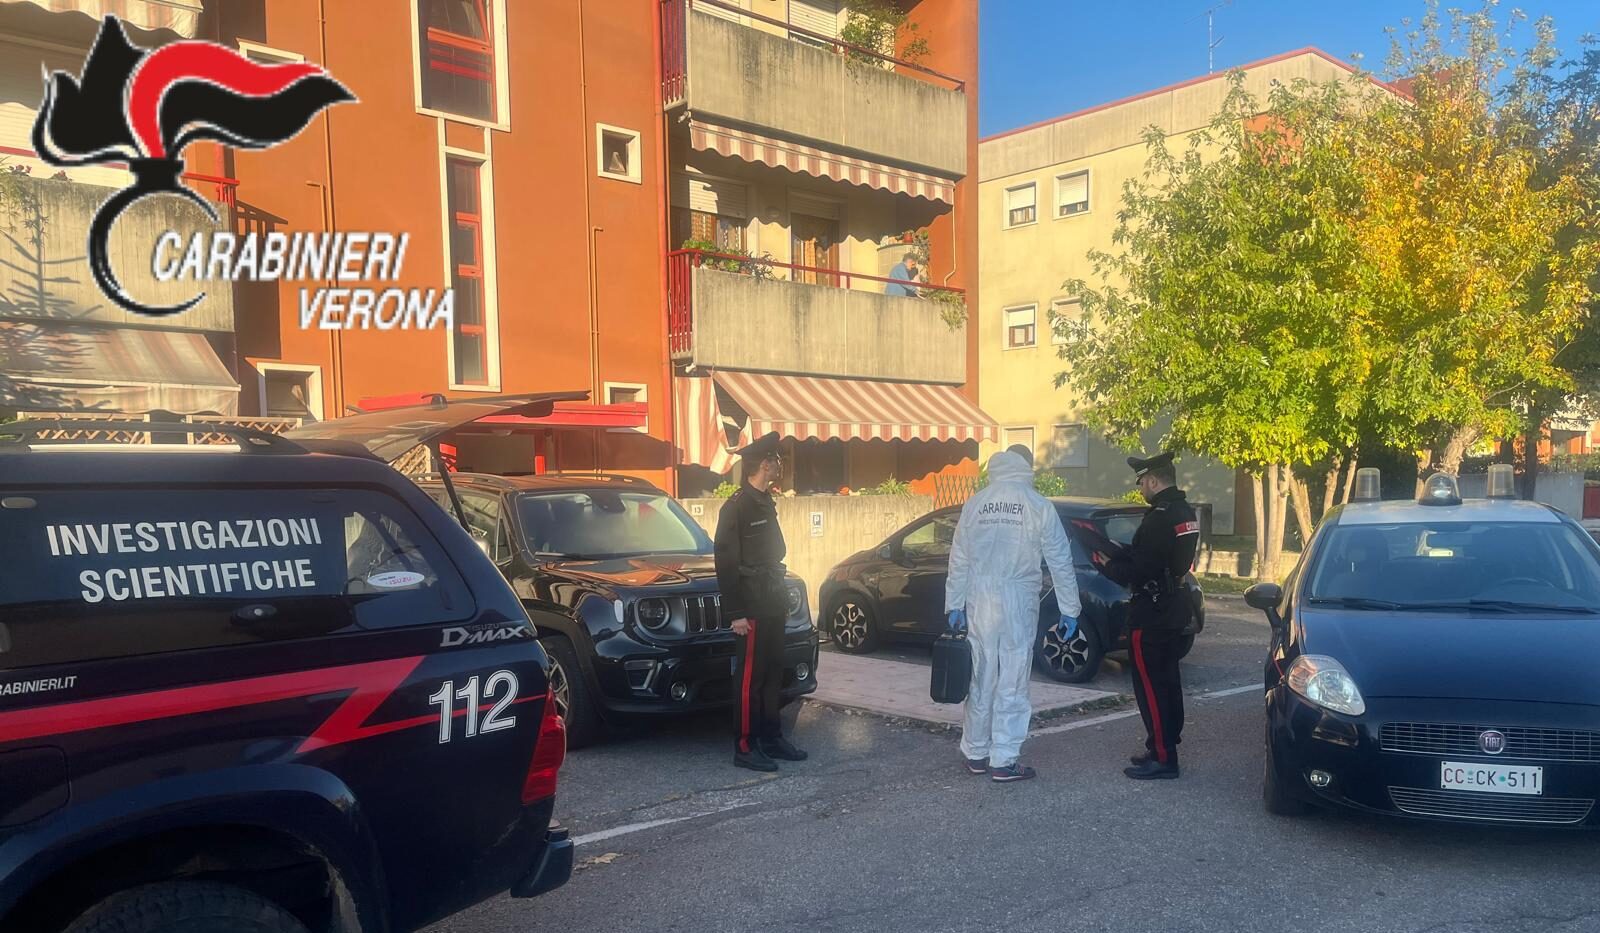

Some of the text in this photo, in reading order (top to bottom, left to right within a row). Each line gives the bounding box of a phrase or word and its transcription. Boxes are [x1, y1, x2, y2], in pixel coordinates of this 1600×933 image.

[46, 517, 322, 556] INVESTIGAZIONI
[79, 558, 316, 603] SCIENTIFICHE
[471, 623, 500, 631] ISUZU
[428, 669, 519, 744] 112
[1484, 736, 1501, 748] FIAT
